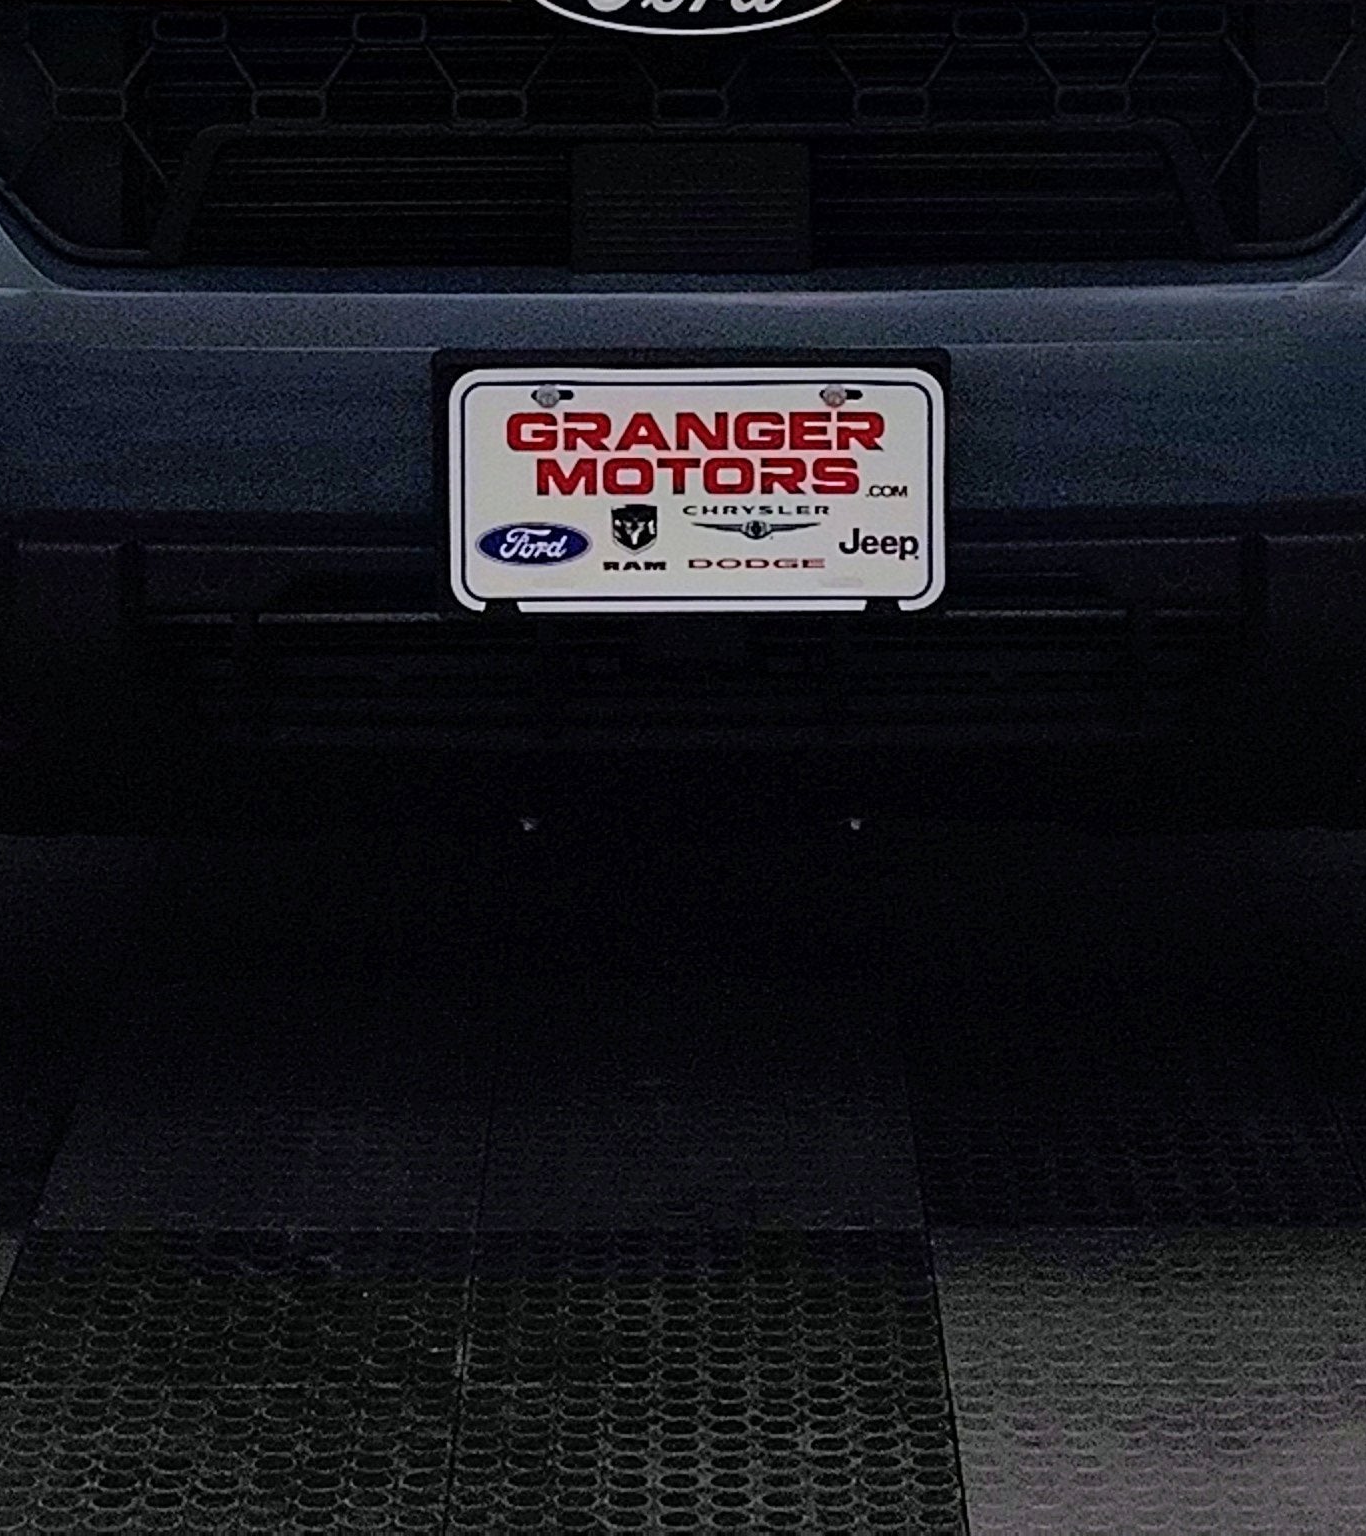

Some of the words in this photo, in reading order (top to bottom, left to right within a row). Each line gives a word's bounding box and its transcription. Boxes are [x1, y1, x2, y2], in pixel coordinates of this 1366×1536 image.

[506, 411, 885, 452] GRANGER
[535, 457, 860, 496] MOTORS
[682, 504, 830, 516] CHRYSLER
[499, 528, 567, 560] Ford
[838, 528, 919, 560] Jeep
[603, 561, 667, 571] RAM
[688, 558, 826, 569] DODGE
